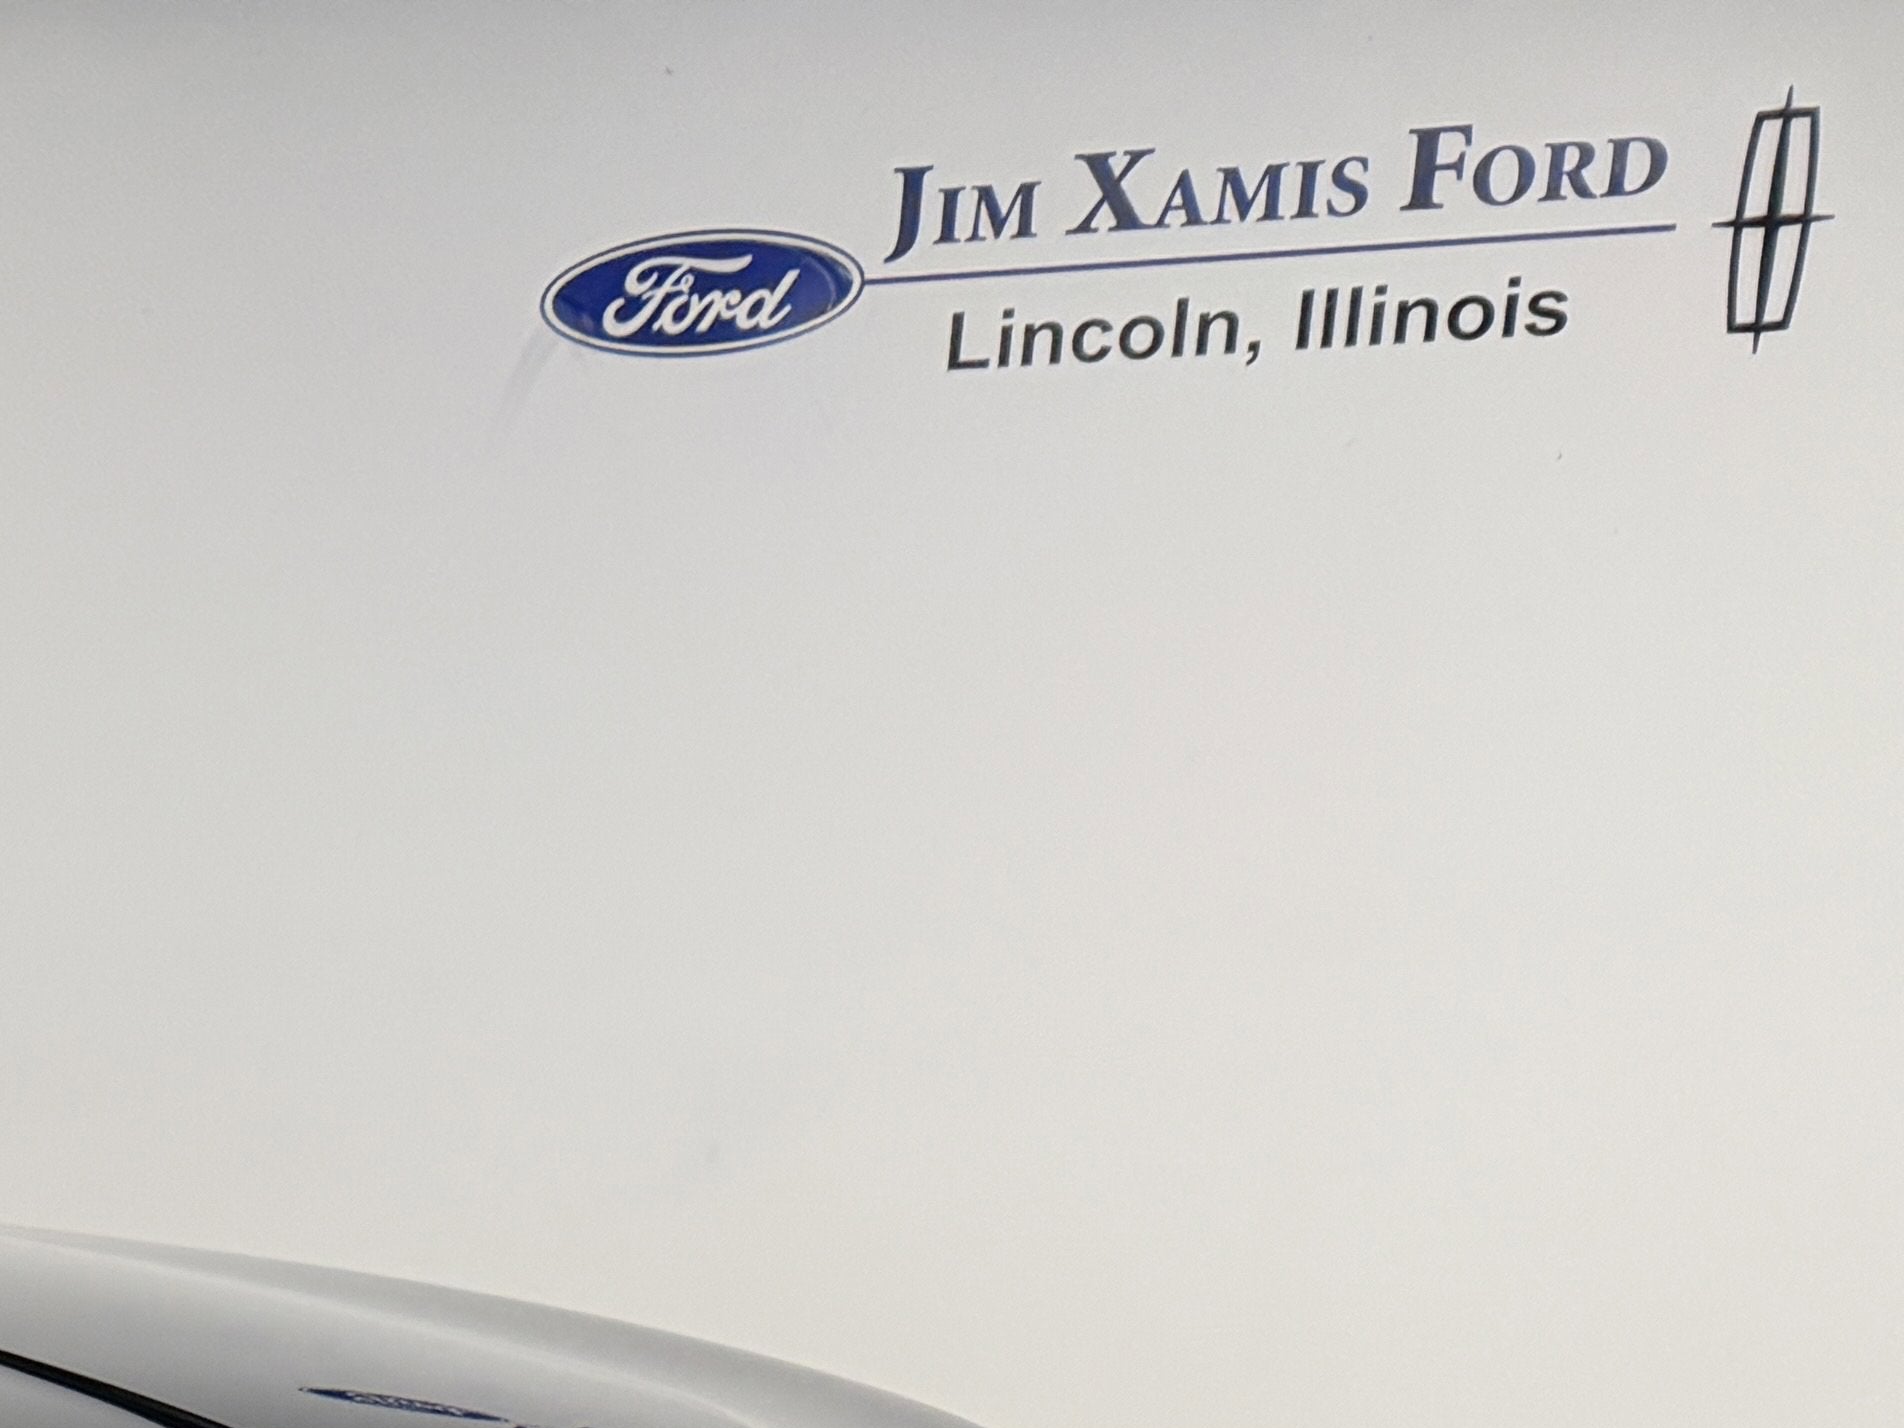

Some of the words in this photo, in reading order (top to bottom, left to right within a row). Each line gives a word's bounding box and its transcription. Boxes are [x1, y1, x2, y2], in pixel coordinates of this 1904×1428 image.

[1399, 124, 1668, 212] FORD
[602, 253, 798, 338] Ford
[947, 297, 1261, 371] Lincoln,
[1295, 276, 1568, 350] Illinois
